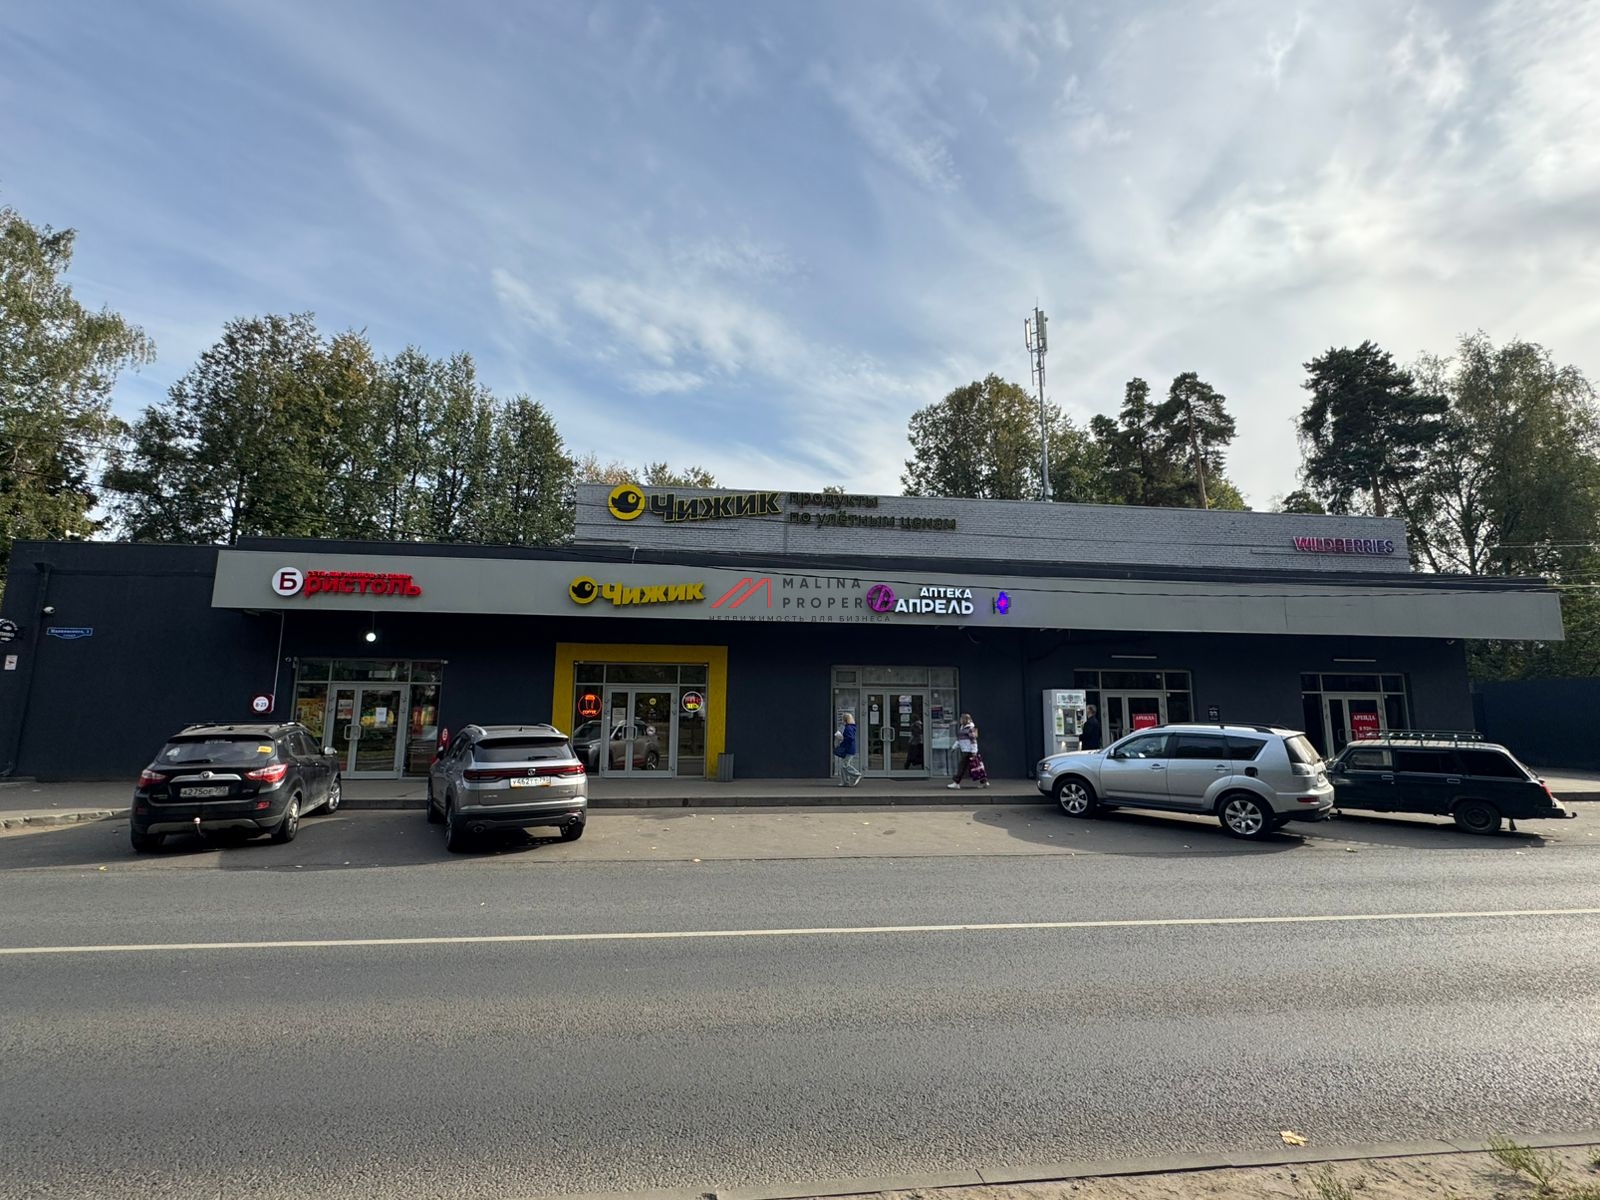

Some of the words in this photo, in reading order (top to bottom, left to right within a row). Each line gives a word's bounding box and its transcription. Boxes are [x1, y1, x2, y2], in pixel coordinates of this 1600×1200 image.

[789, 492, 878, 508] продукты
[789, 512, 811, 523] по
[817, 511, 896, 528] улётным
[900, 517, 957, 530] ценам
[1293, 536, 1394, 554] WILDBERRIES
[920, 586, 973, 599] АПТЕКА
[894, 599, 974, 615] АПРЕЛЬ
